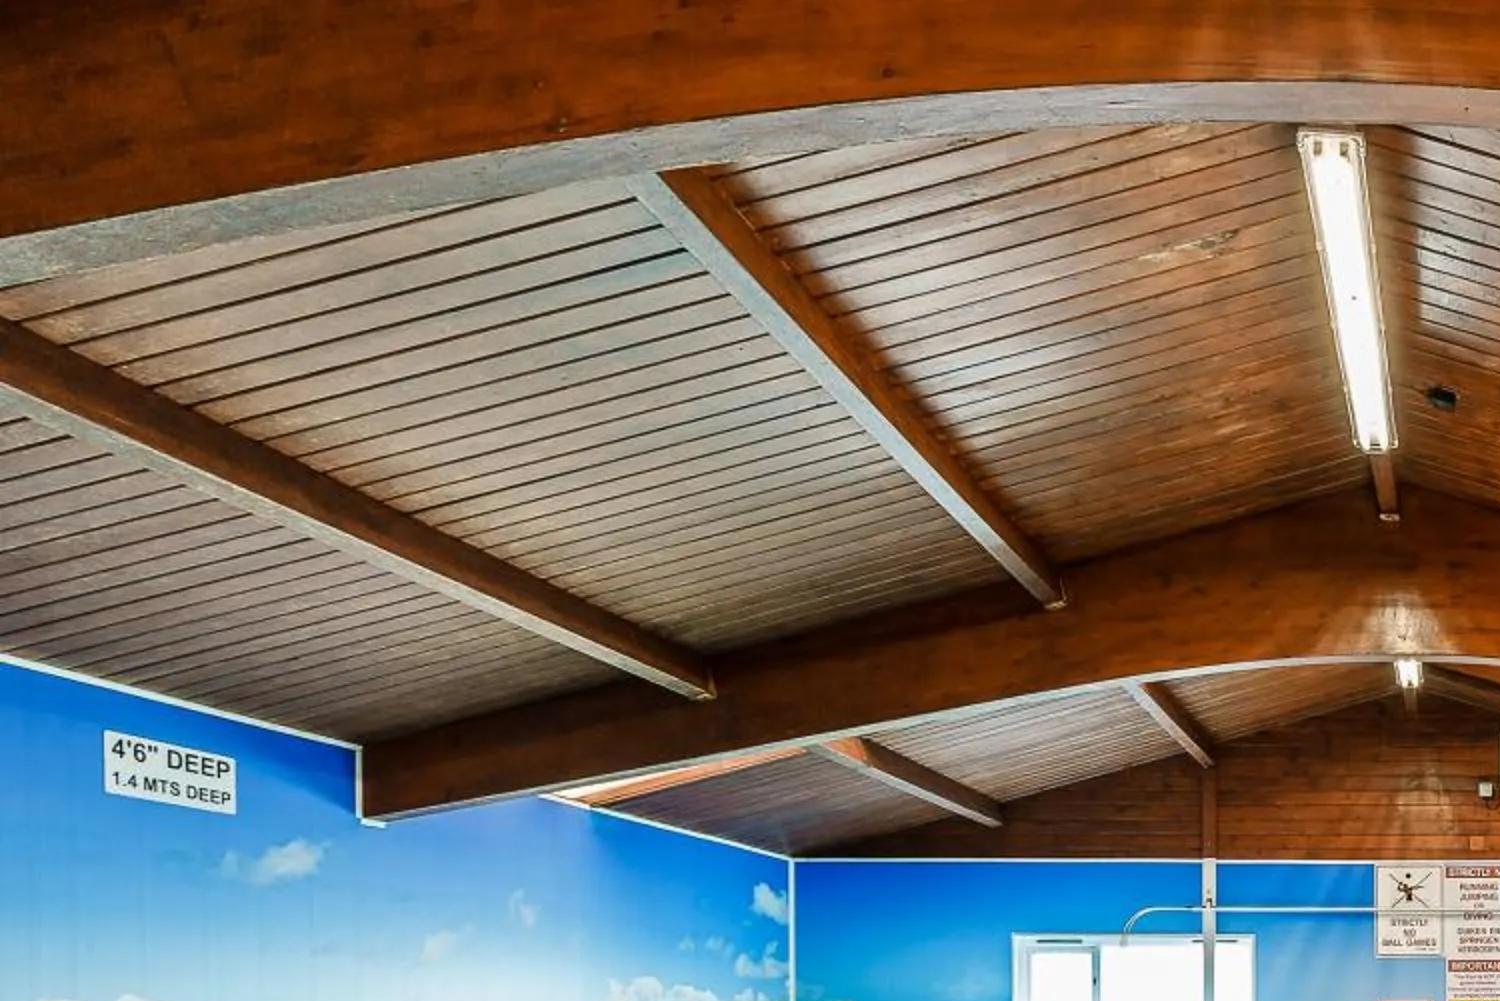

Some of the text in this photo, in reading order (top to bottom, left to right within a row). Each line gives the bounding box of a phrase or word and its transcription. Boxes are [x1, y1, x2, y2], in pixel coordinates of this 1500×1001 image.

[111, 738, 231, 779] 4'6" DEEP
[112, 771, 231, 805] 1.4 MTS DEEP
[1459, 892, 1499, 901] JUMPING
[1463, 911, 1494, 921] DIVING
[1390, 918, 1428, 927] STRICTLY
[1403, 928, 1417, 938] NO
[1381, 938, 1437, 947] BALL GAMES
